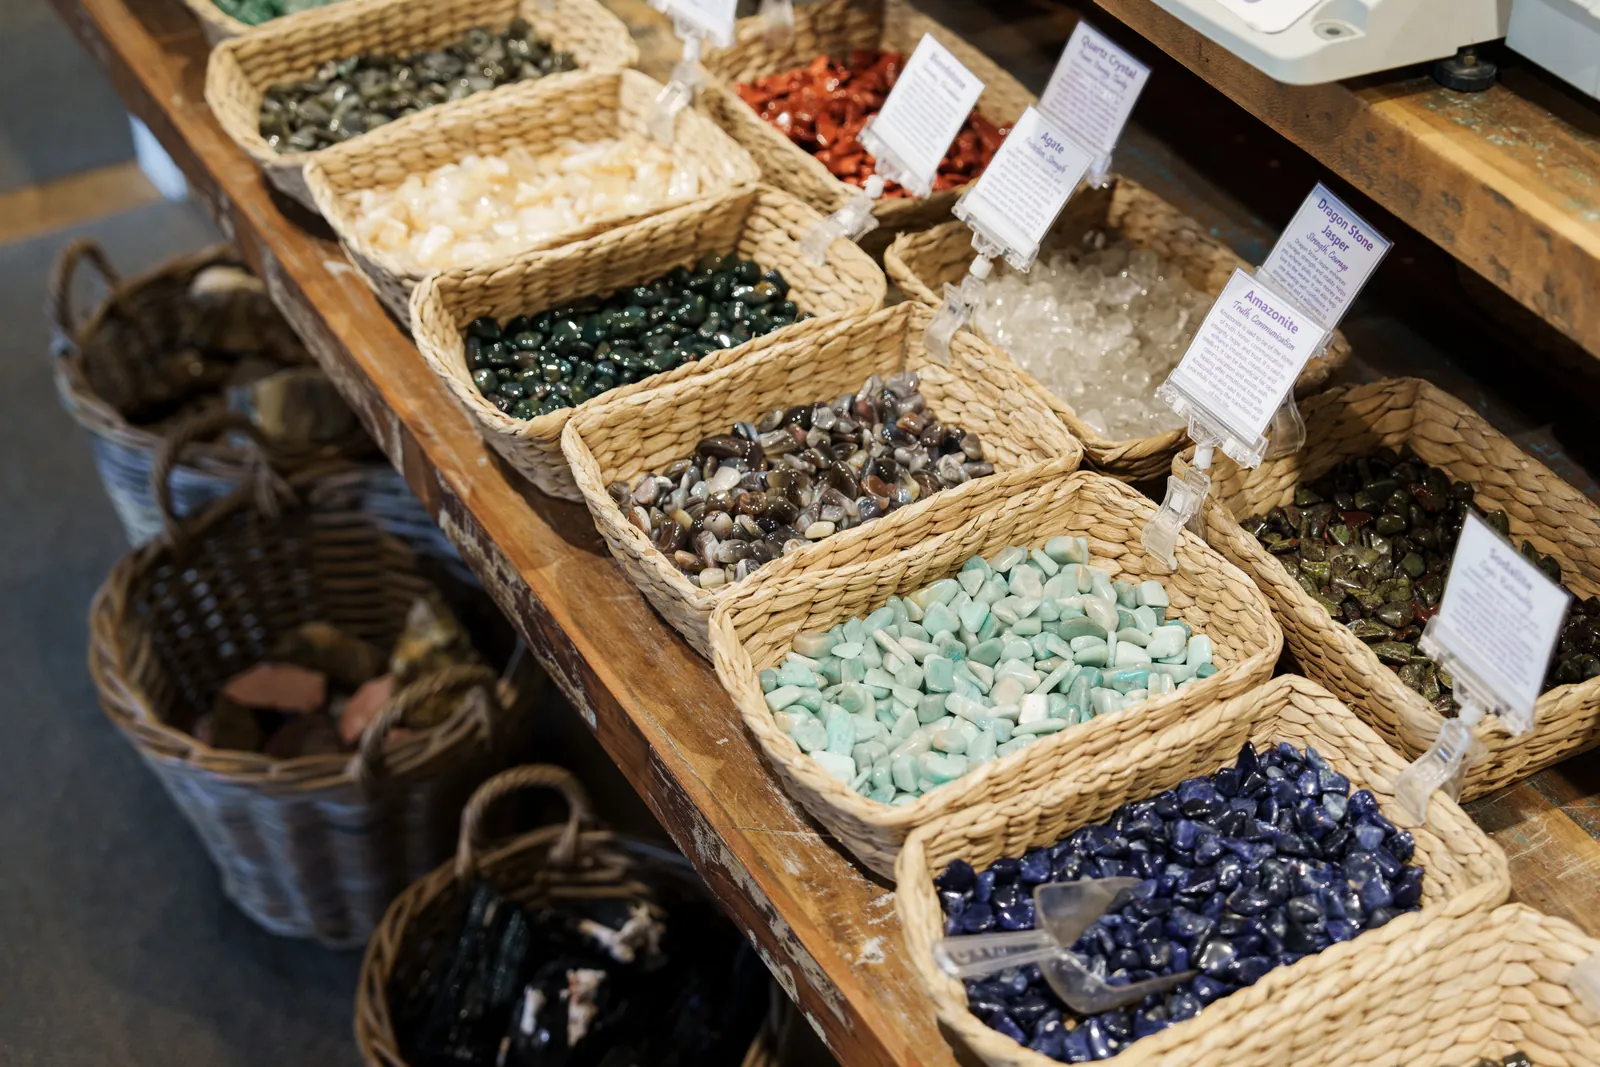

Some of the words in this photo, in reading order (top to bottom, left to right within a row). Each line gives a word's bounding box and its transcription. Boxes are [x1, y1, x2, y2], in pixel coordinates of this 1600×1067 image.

[1081, 35, 1108, 58] Quartz
[1109, 54, 1138, 80] Crystal
[1041, 132, 1064, 155] Agate
[1317, 198, 1349, 230] Dragon
[1347, 225, 1374, 252] Stone
[1321, 225, 1350, 252] Jasper
[1306, 232, 1329, 256] Strength,
[1328, 251, 1349, 272] Courage
[1219, 308, 1242, 327] Amazonite
[1246, 328, 1256, 338] said
[1273, 347, 1281, 356] the
[1232, 300, 1251, 318] Truth,
[1250, 314, 1296, 351] Communication
[1244, 289, 1299, 335] Amazonite
[1223, 352, 1232, 361] can
[1241, 345, 1251, 355] and
[1270, 366, 1281, 377] said
